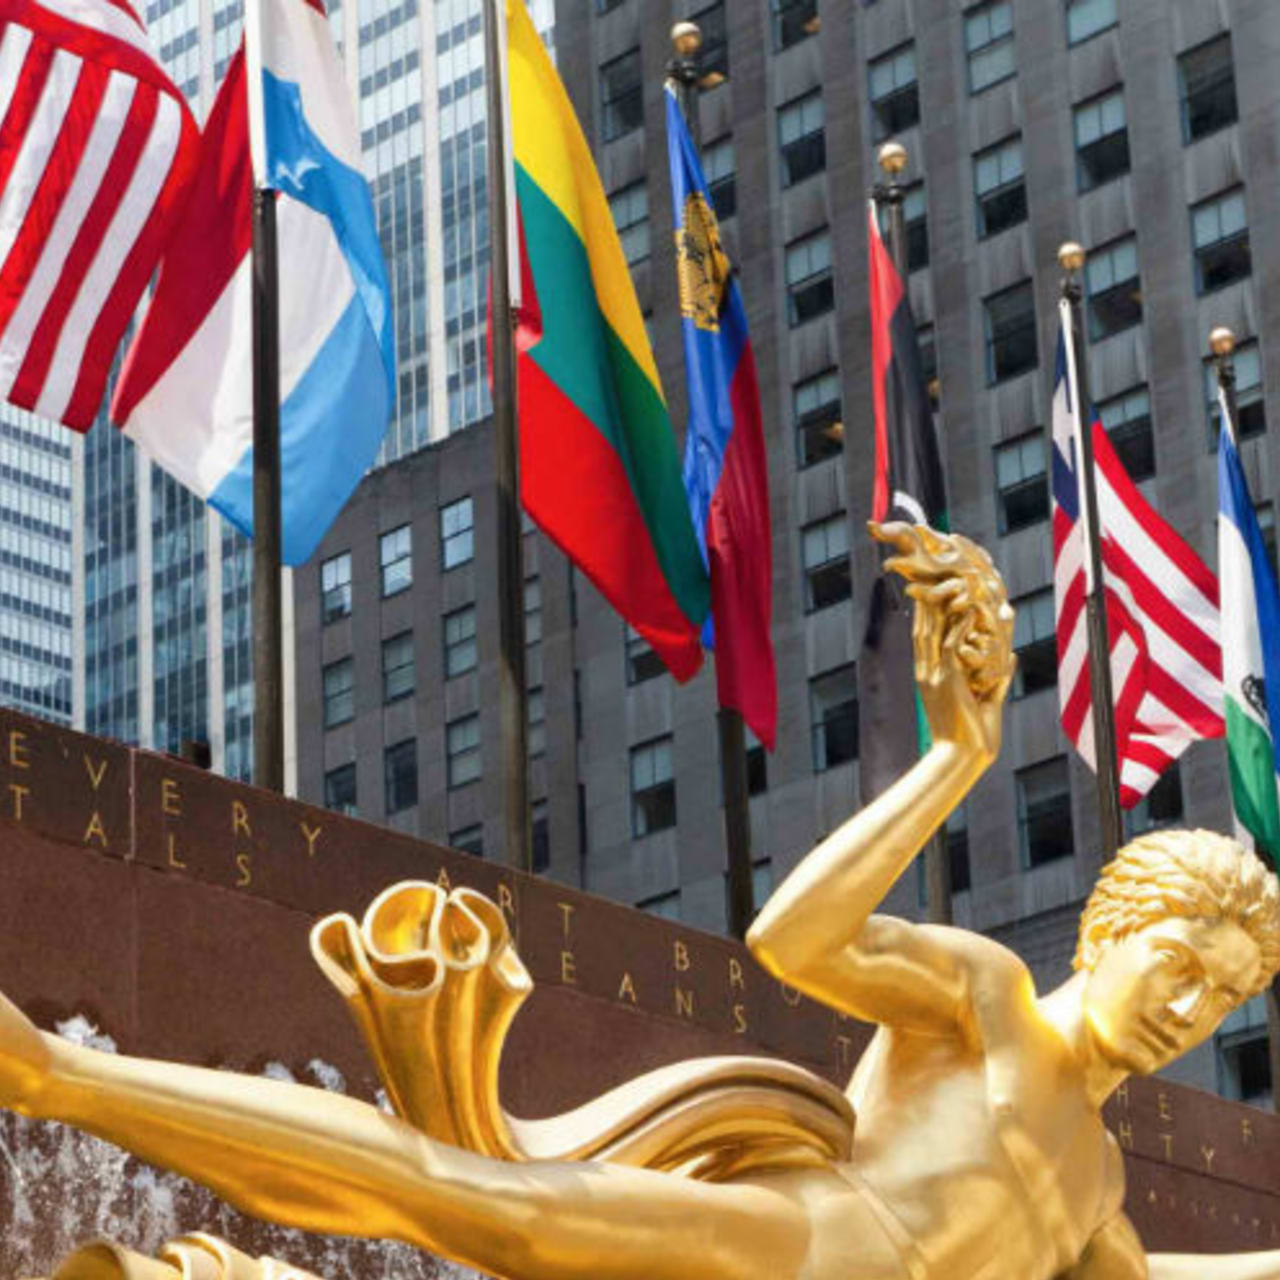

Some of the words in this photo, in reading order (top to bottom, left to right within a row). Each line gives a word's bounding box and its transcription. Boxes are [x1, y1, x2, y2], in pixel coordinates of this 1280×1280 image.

[9, 731, 322, 856] EVERY
[437, 866, 575, 935] ART
[561, 951, 748, 1034] EANS
